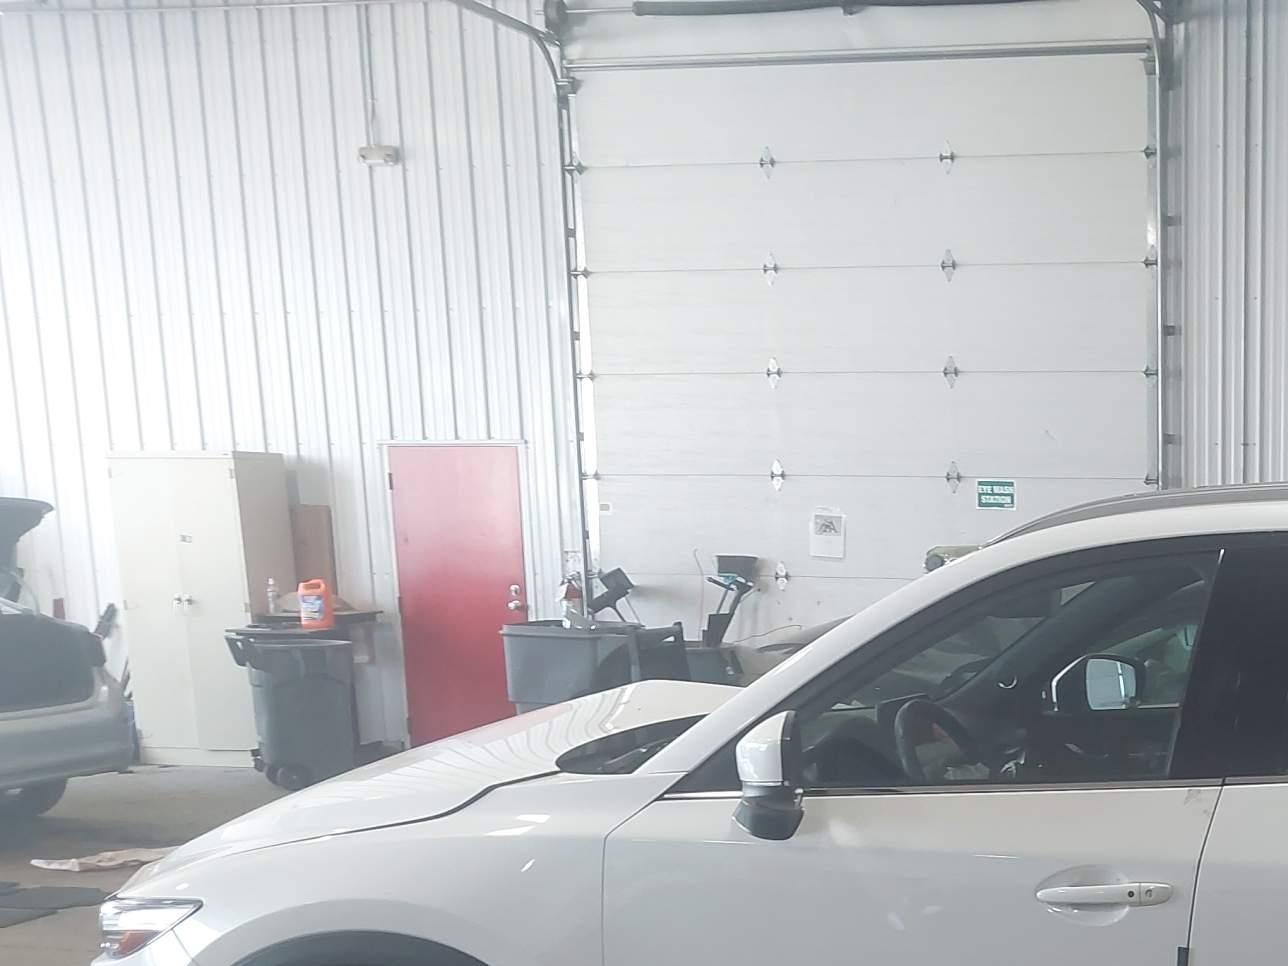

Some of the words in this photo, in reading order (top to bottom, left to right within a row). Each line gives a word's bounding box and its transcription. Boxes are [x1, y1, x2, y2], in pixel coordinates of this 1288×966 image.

[978, 485, 993, 494] EYE
[993, 485, 1014, 494] WASH
[980, 495, 1011, 504] STATION
